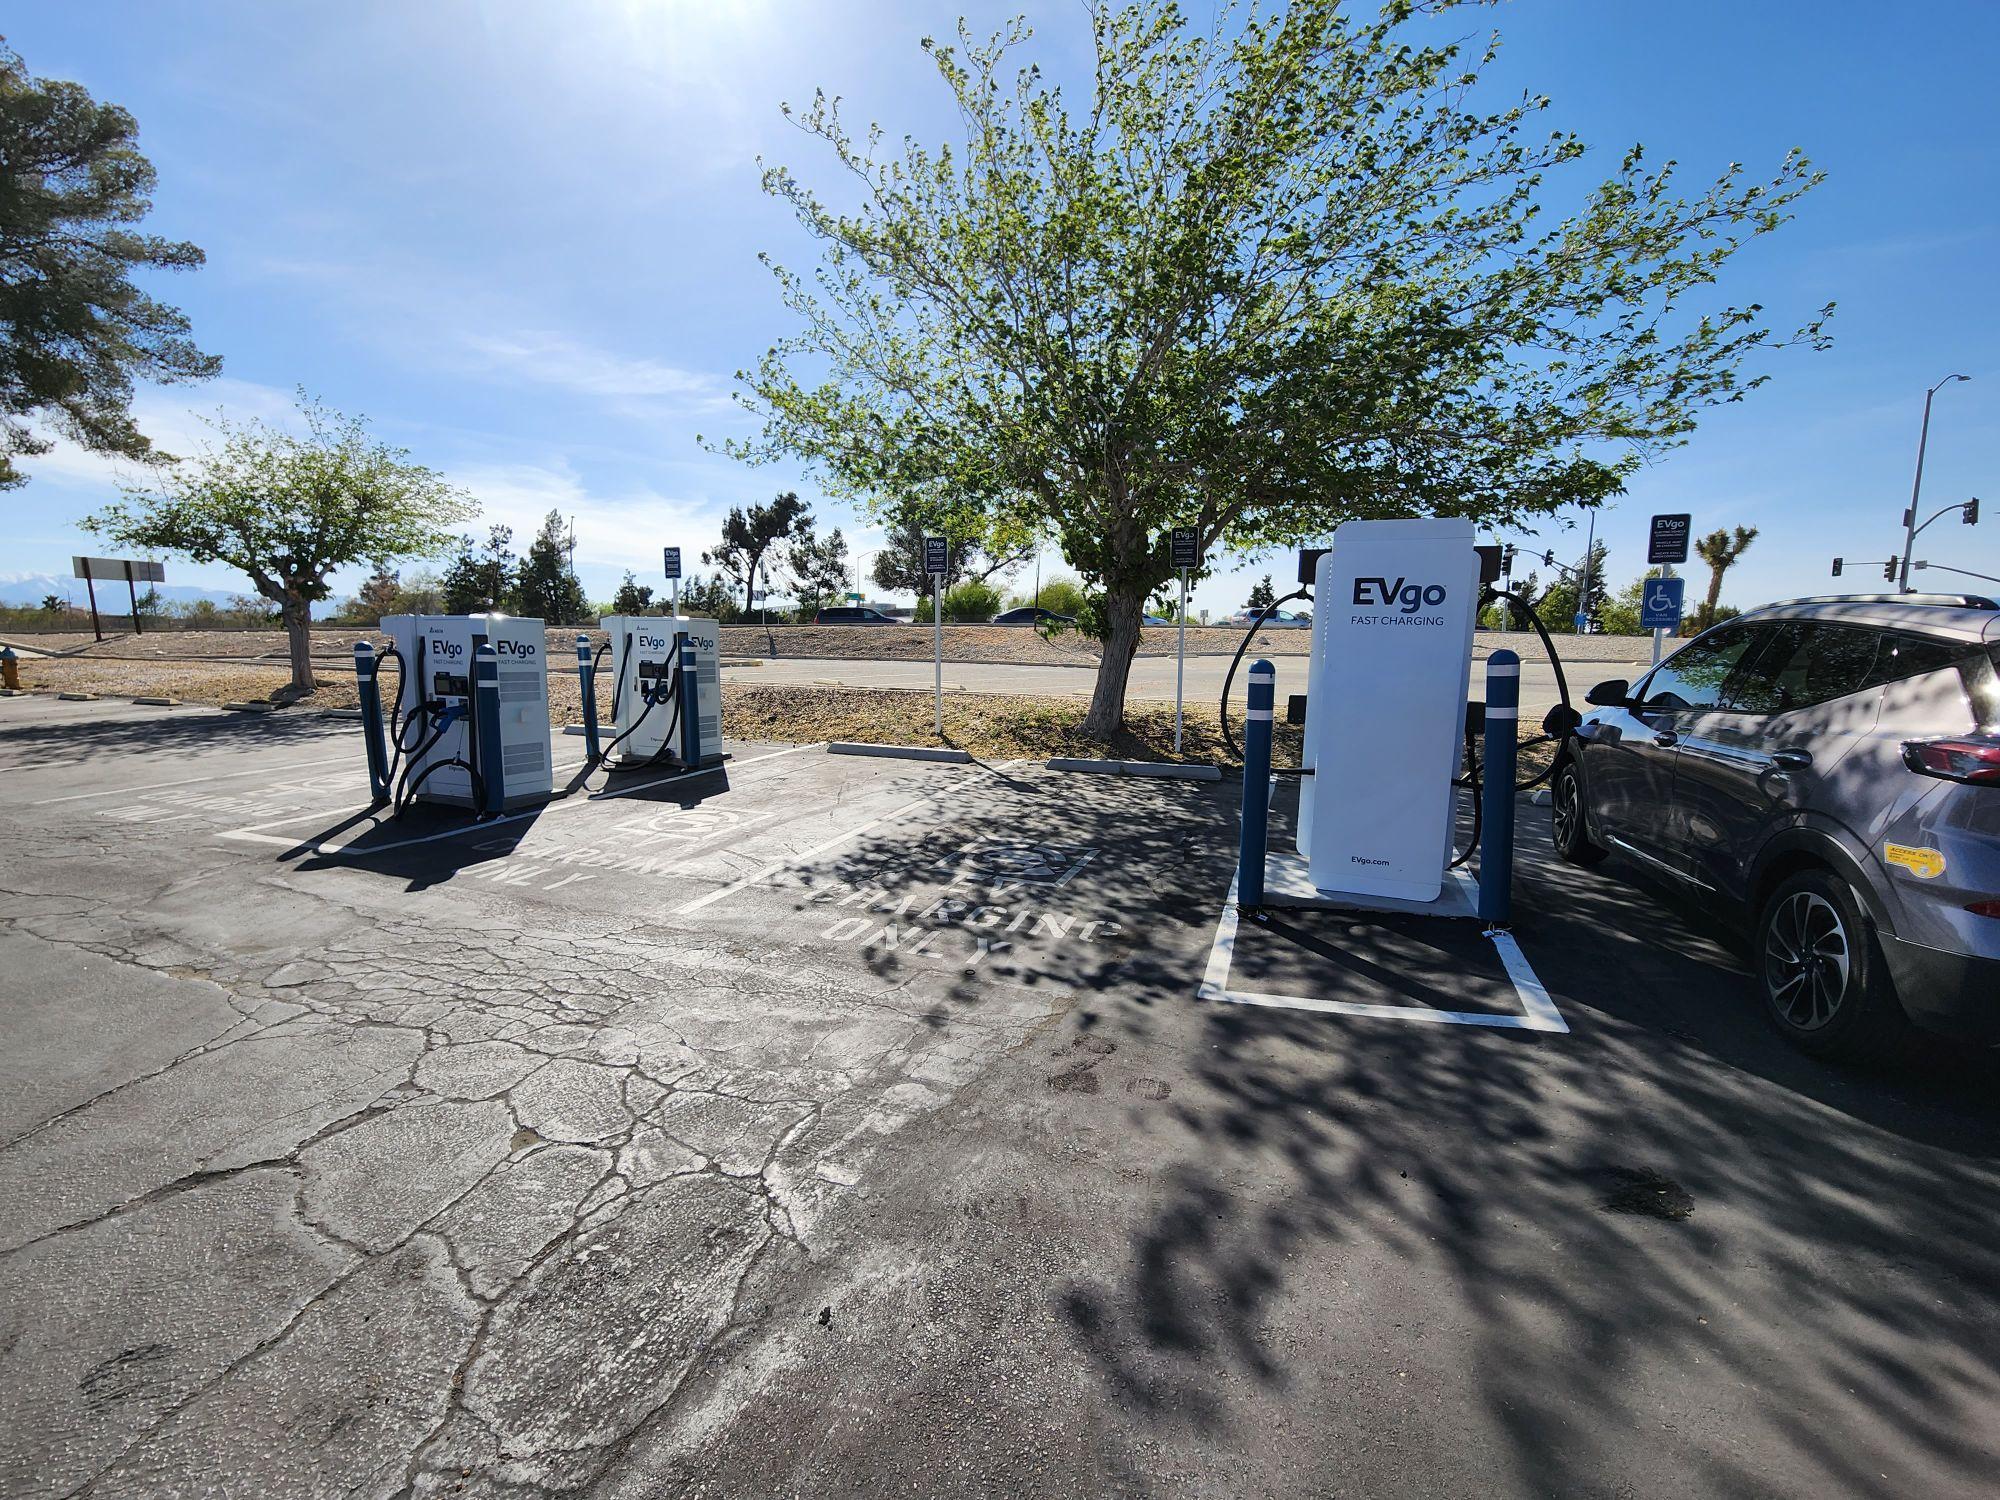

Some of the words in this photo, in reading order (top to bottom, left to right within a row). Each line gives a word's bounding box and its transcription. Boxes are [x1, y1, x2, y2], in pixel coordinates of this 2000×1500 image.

[1657, 519, 1685, 529] EVgo
[1175, 531, 1195, 540] EVgo
[929, 540, 945, 548] EVgo
[1352, 577, 1447, 614] EVgo
[1350, 615, 1379, 625] FAST
[1380, 616, 1445, 626] CHARGING
[432, 640, 463, 659] EVgo
[497, 640, 536, 659] EVgo
[640, 635, 665, 650] EVgo
[1351, 856, 1390, 866] EVgo.com
[802, 883, 1124, 943] CHARGING
[820, 917, 1013, 965] ONLY
